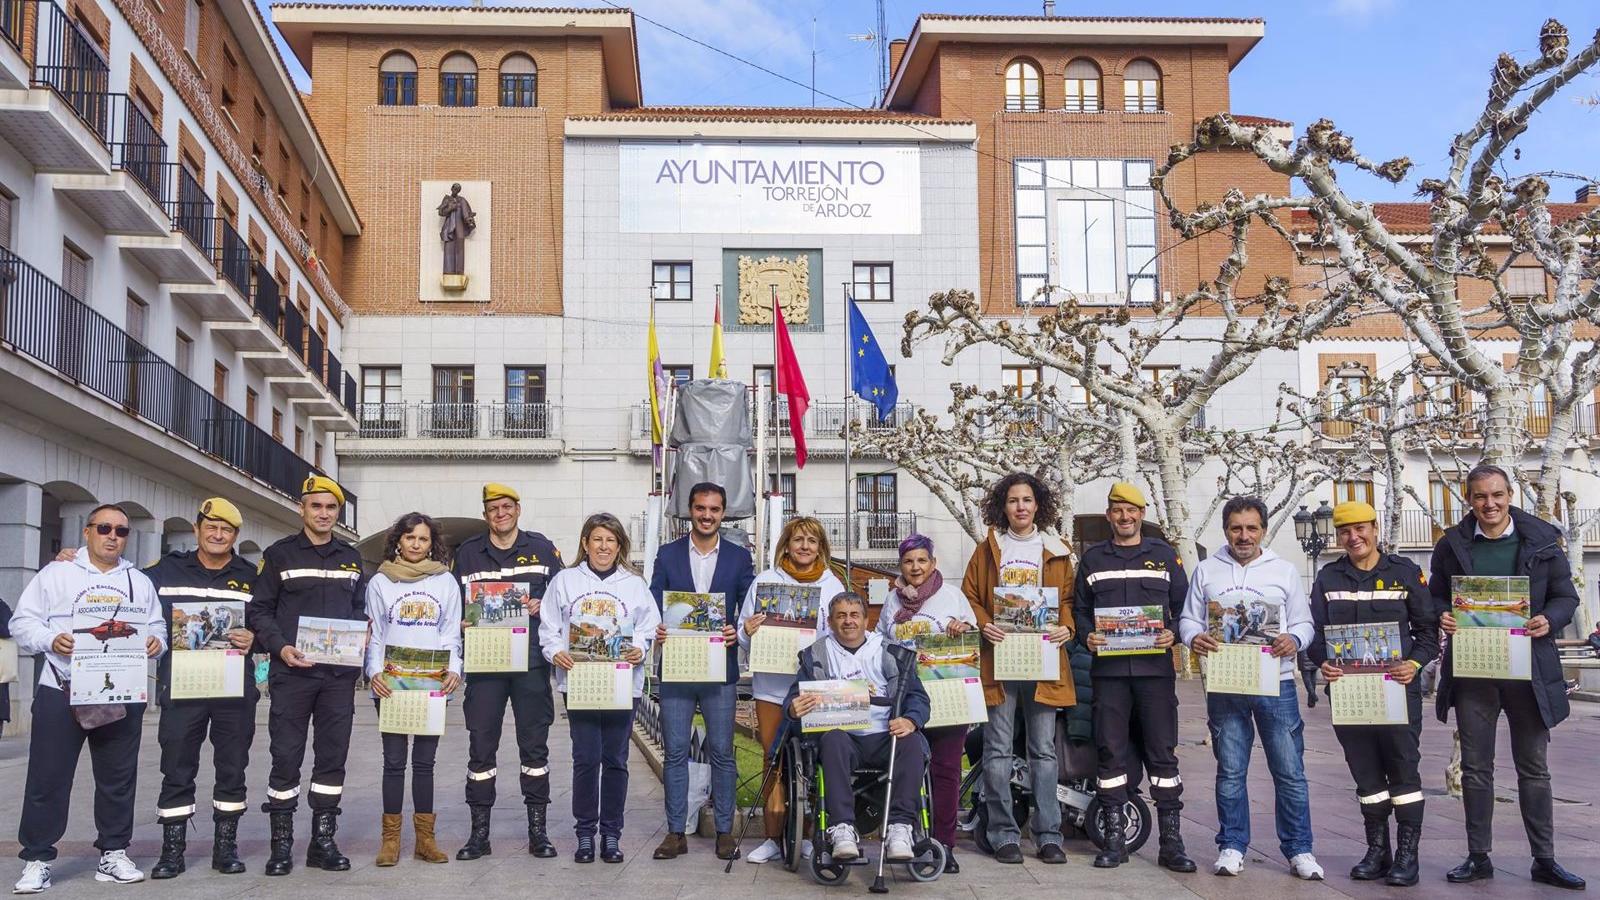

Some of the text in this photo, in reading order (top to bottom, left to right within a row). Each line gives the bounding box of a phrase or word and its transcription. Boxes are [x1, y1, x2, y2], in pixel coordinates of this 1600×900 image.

[655, 159, 885, 186] AYUNTAMIENTO
[762, 184, 848, 204] TORREJÓN
[803, 204, 872, 218] DE ARDOZ
